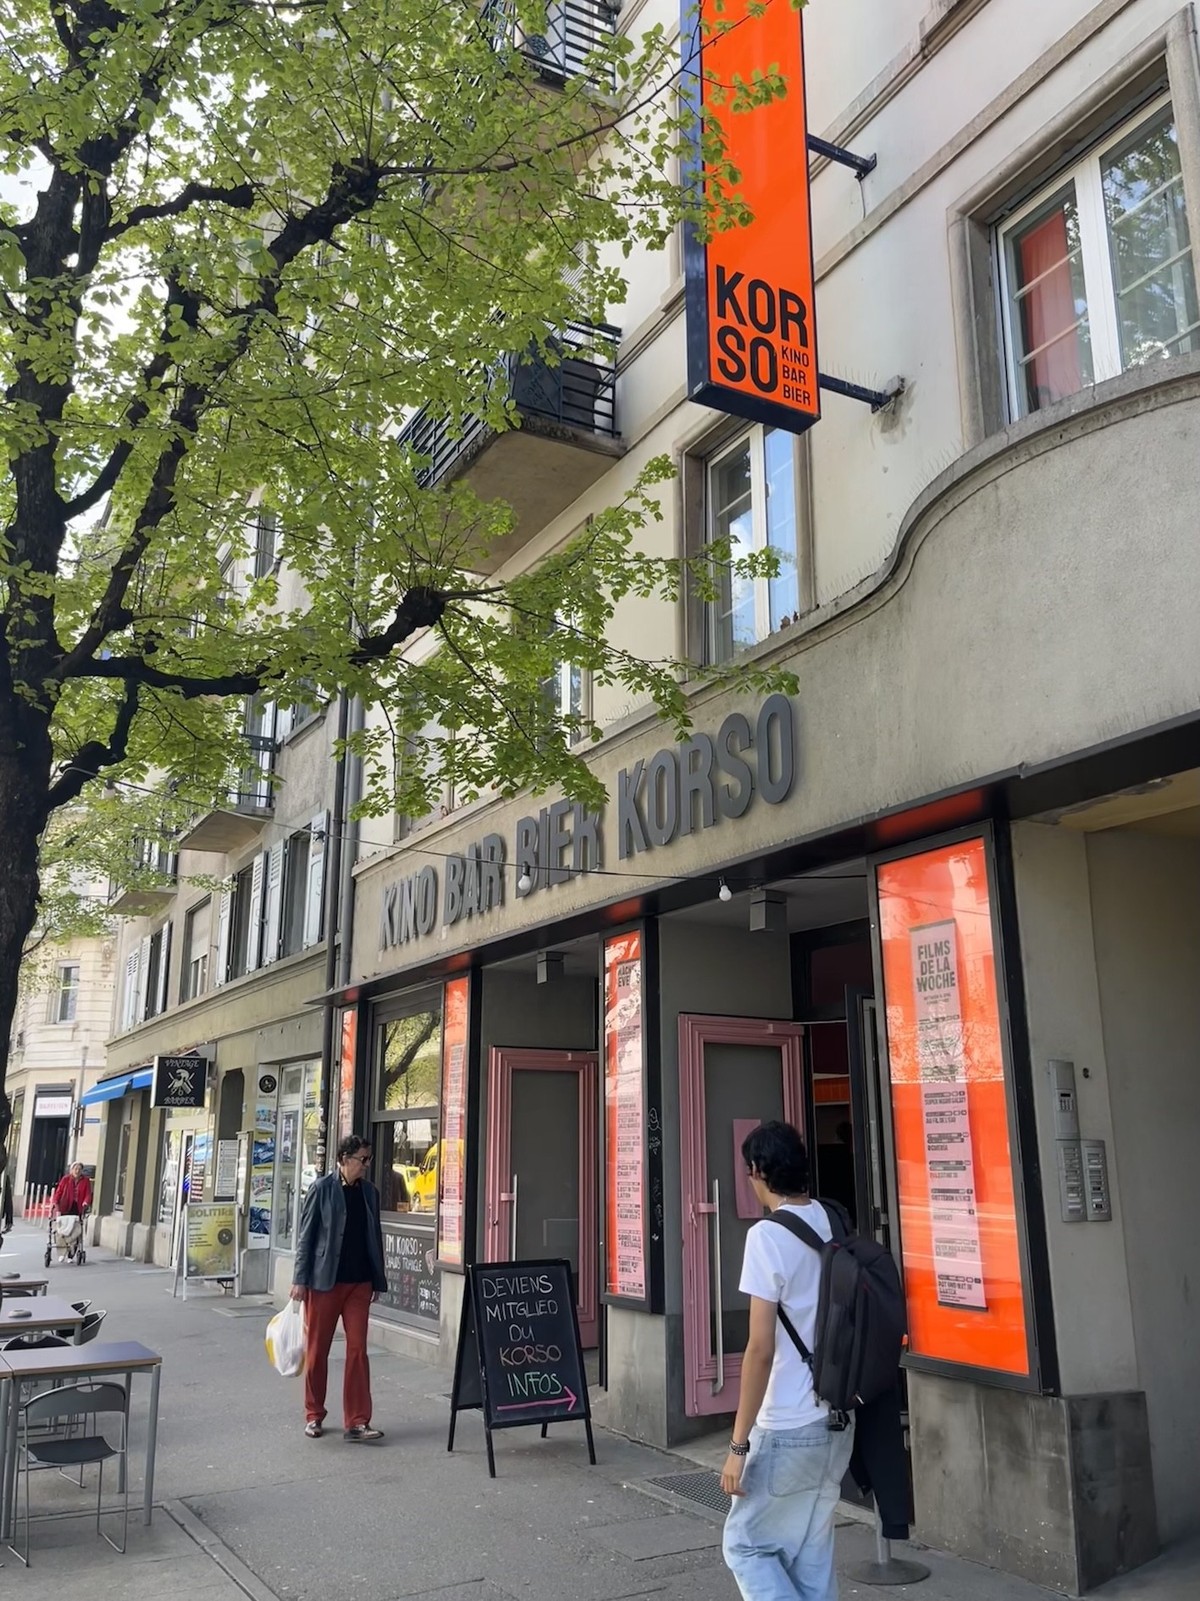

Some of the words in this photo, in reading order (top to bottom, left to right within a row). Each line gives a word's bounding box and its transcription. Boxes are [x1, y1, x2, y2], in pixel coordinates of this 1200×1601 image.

[716, 264, 808, 348] KOR
[717, 325, 778, 393] SO
[781, 345, 810, 367] KINO
[782, 364, 807, 385] BAR
[783, 385, 811, 406] BIER
[380, 864, 436, 951] KINO
[443, 833, 505, 927] BAR
[618, 693, 795, 860] KORSO
[917, 940, 951, 960] FILMS
[920, 959, 935, 976] DE
[936, 957, 951, 973] LA
[916, 971, 956, 993] WOCHE
[481, 1274, 554, 1299] DEVIENS
[485, 1299, 559, 1323] MITGLIED
[499, 1344, 563, 1367] KORSO
[507, 1371, 564, 1397] INFOS
